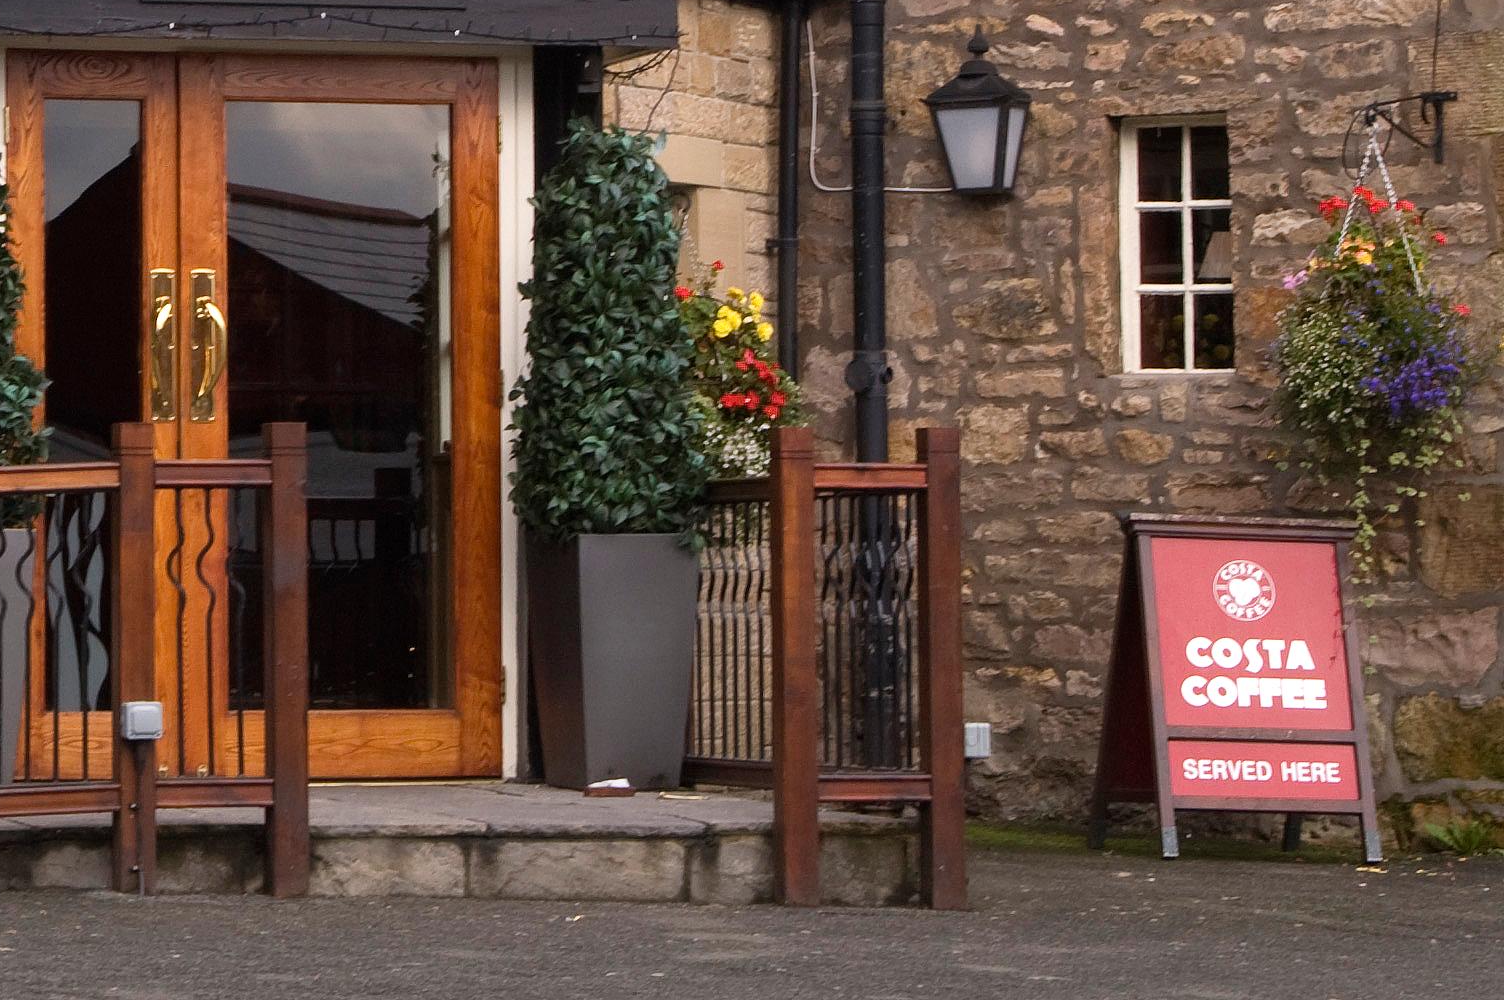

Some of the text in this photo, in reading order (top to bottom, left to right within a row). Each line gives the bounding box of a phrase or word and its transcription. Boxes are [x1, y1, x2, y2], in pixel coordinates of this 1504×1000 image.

[1220, 562, 1264, 581] COSTA
[1219, 594, 1271, 619] COFFEE
[1185, 636, 1316, 673] COSTA
[1181, 675, 1328, 709] COFFEE
[1182, 759, 1341, 783] SERVED HERE
